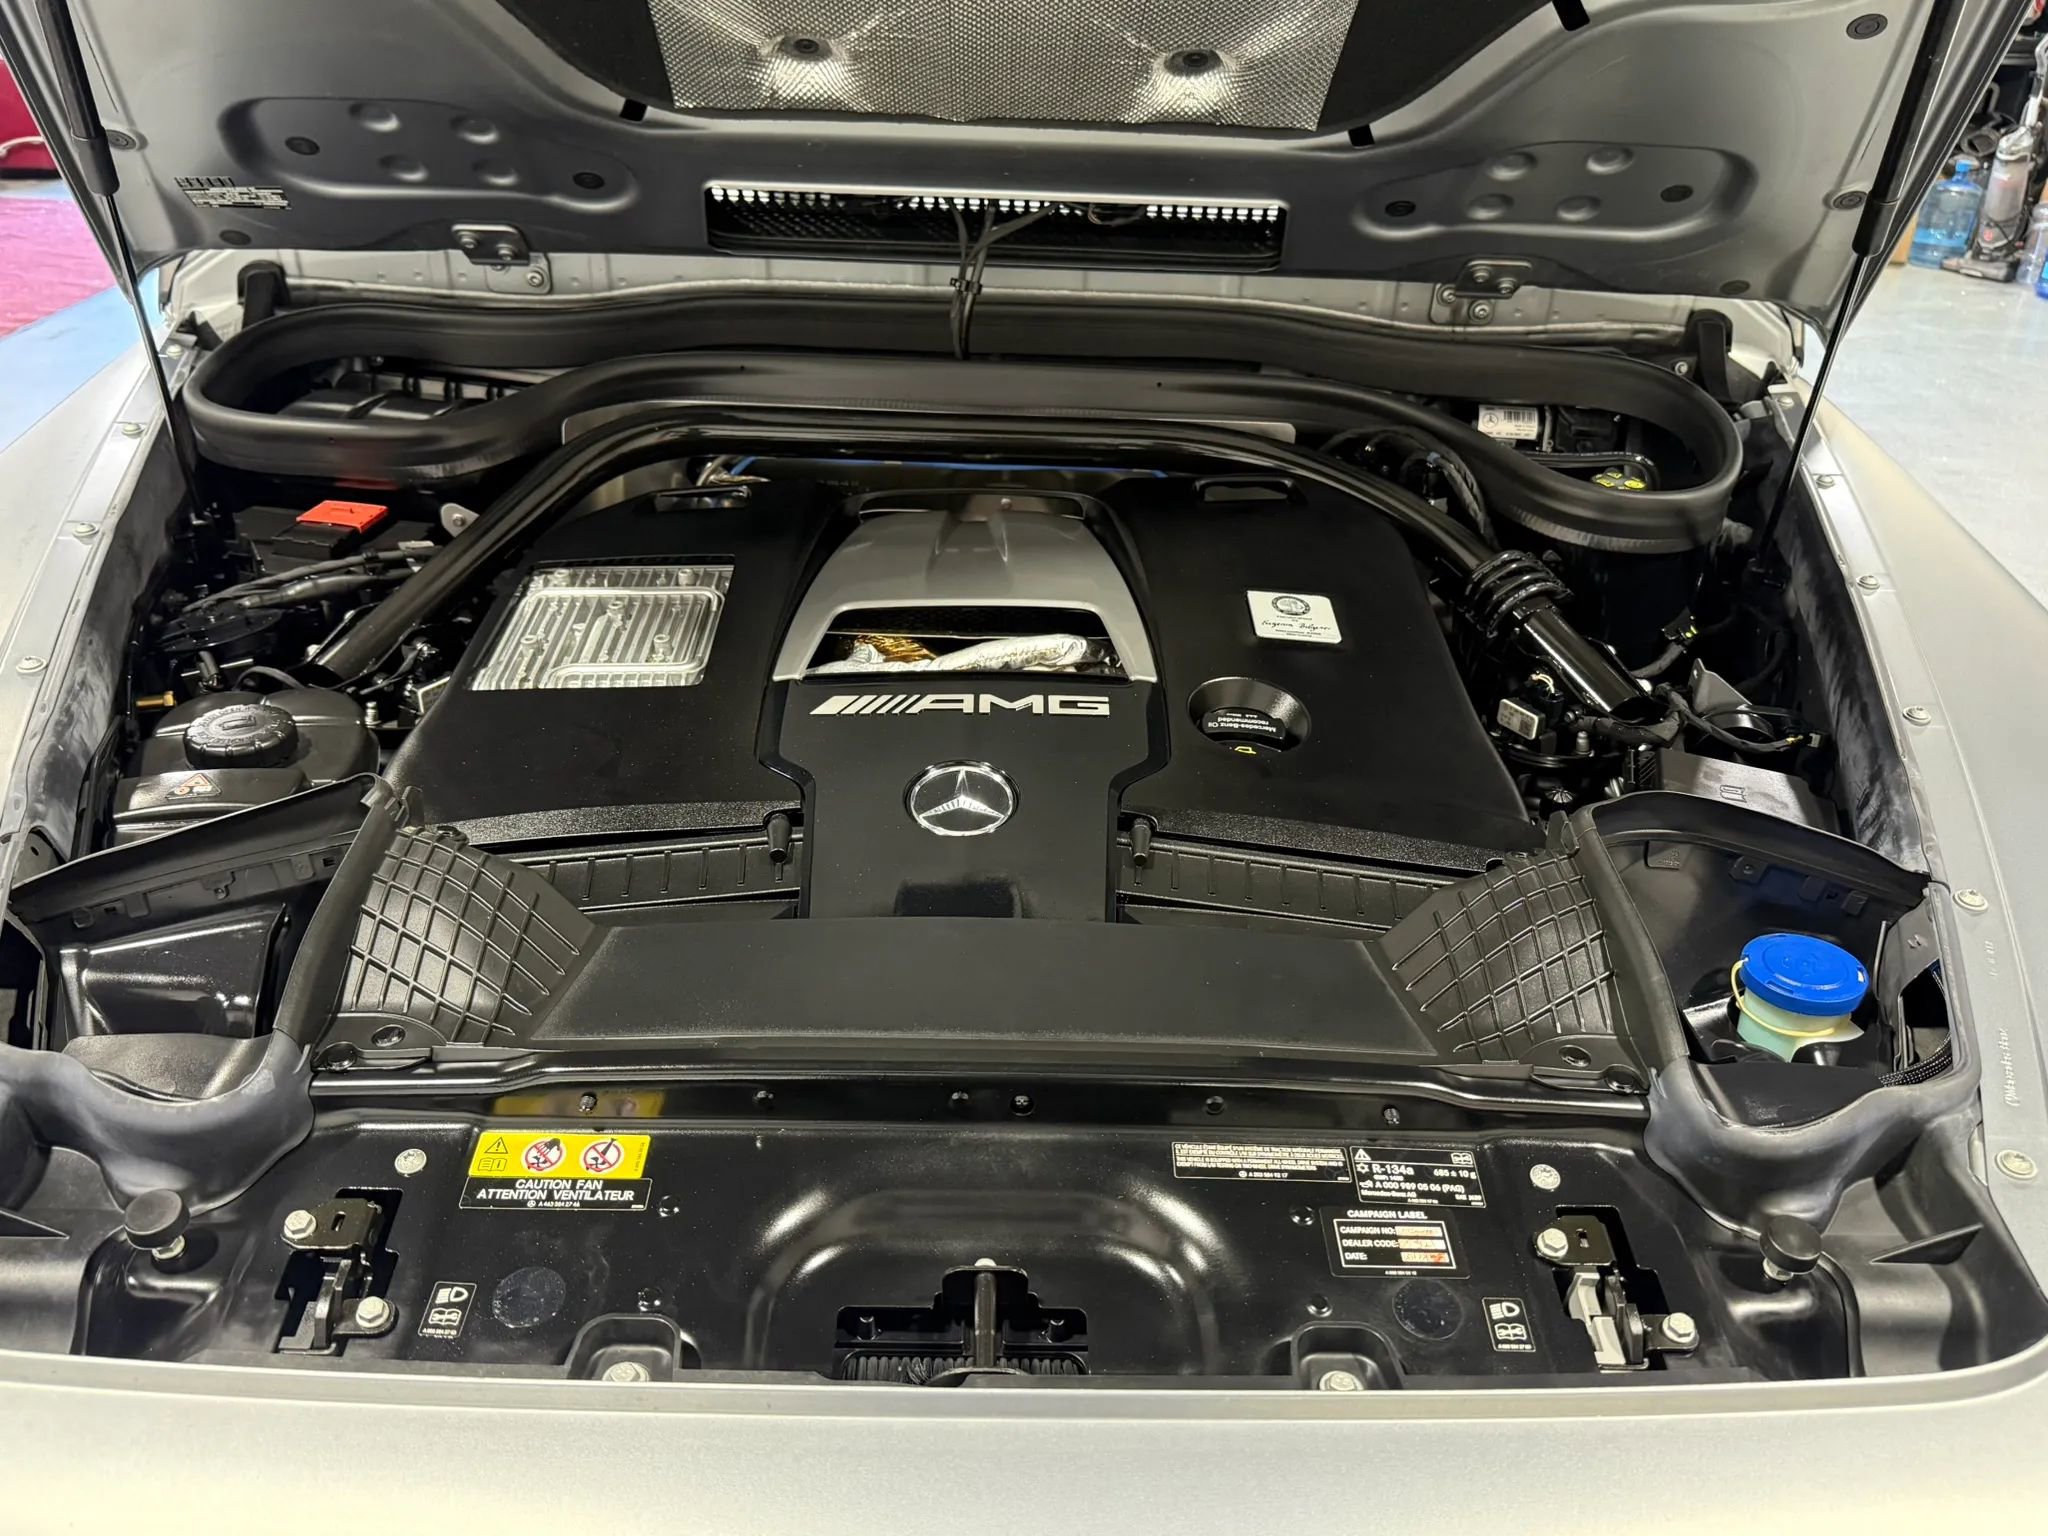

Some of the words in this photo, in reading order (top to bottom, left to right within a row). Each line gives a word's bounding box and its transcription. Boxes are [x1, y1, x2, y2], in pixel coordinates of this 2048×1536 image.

[905, 694, 1110, 716] AMG
[1217, 716, 1269, 725] recommended
[1220, 722, 1276, 732] Mercedes-Benz
[1371, 1163, 1414, 1176] R-134a
[1433, 1168, 1450, 1177] 685
[1459, 1170, 1469, 1178] 10
[515, 1179, 572, 1190] CAUTION
[575, 1179, 603, 1190] FAN
[1382, 1181, 1399, 1189] 000
[1429, 1183, 1441, 1191] 06
[1442, 1184, 1465, 1194] (PAG)
[476, 1189, 546, 1200] ATTENTION
[553, 1189, 635, 1201] VENTILATEUR
[1346, 1209, 1397, 1219] CAMPAIGN
[1398, 1211, 1428, 1219] LABEL
[1340, 1226, 1380, 1234] CAMPAIGN
[1381, 1227, 1396, 1235] NO:
[1342, 1239, 1373, 1247] DEALER
[1374, 1240, 1399, 1248] CODE:
[1344, 1252, 1368, 1260] DATE:
